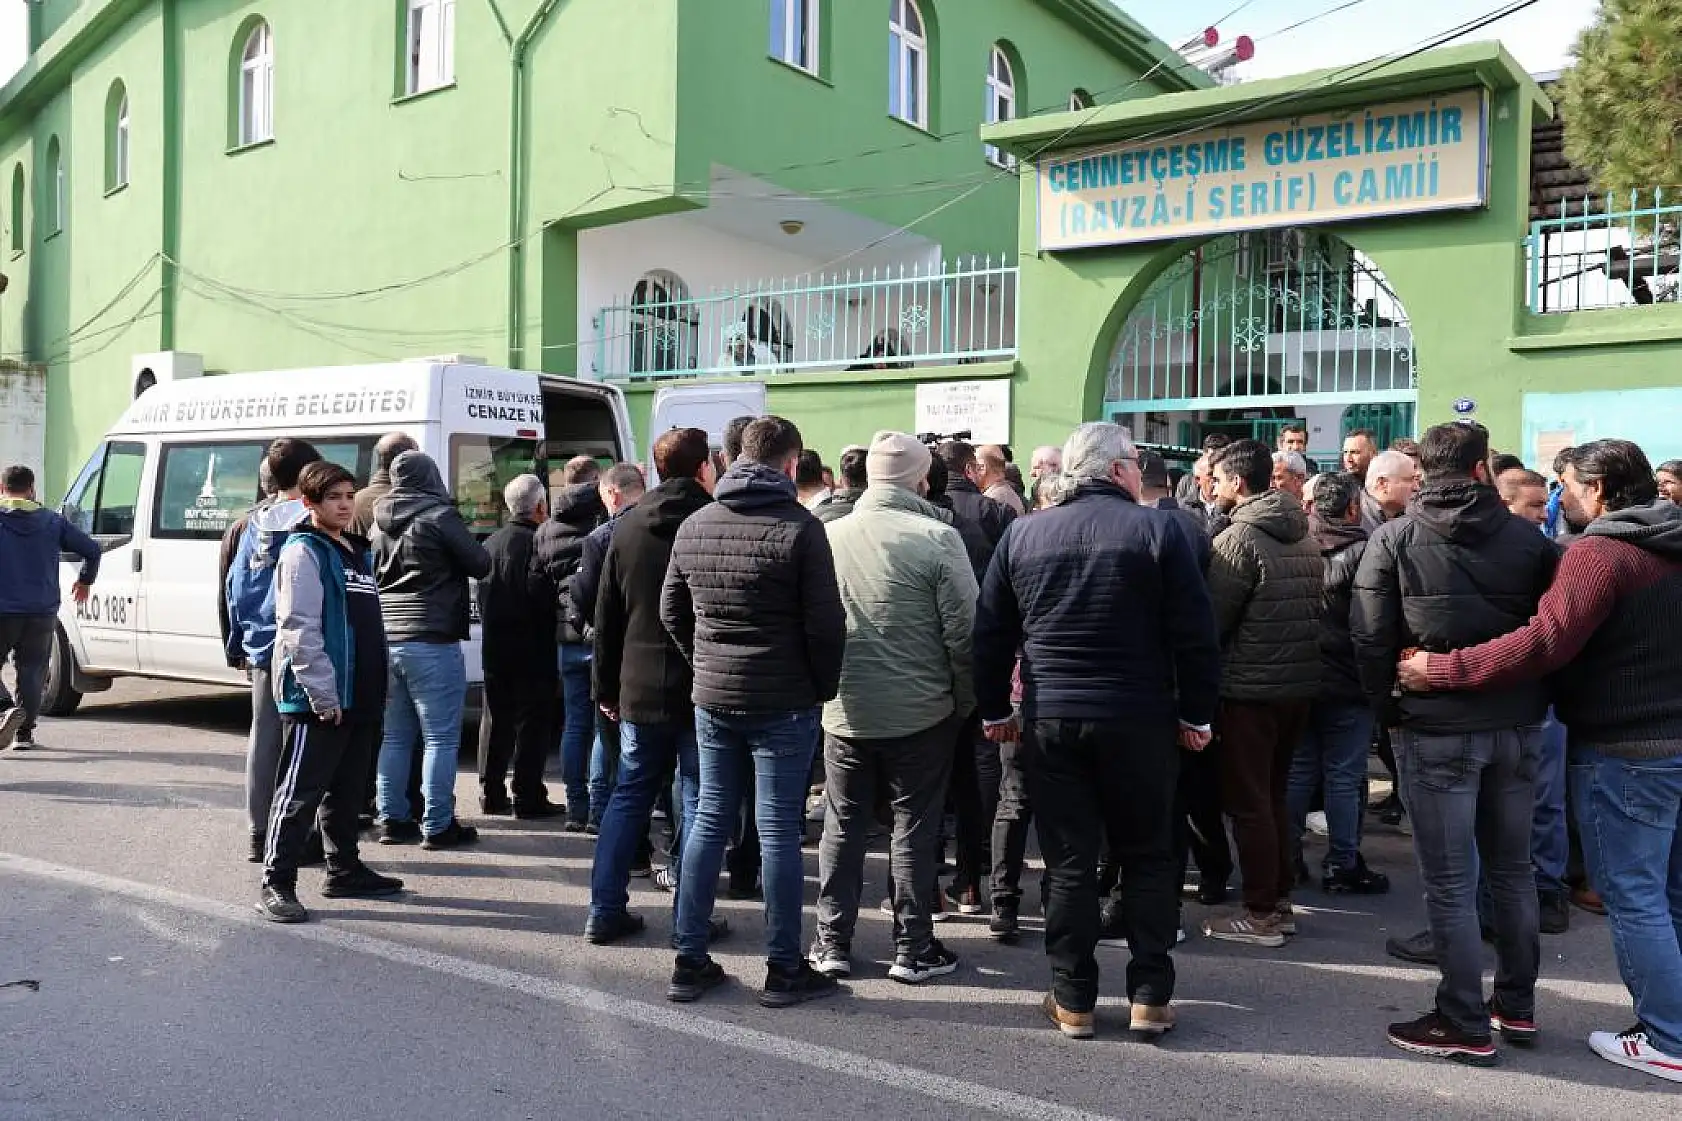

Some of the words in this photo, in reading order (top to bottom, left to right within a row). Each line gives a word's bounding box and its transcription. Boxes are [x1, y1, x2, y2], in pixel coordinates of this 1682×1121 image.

[1048, 137, 1245, 194] CENNETÇEŞME
[1208, 171, 1317, 223] ŞERİF)
[1333, 151, 1439, 206] CAMİİ
[468, 404, 525, 422] CENAZE
[104, 596, 127, 624] 188
